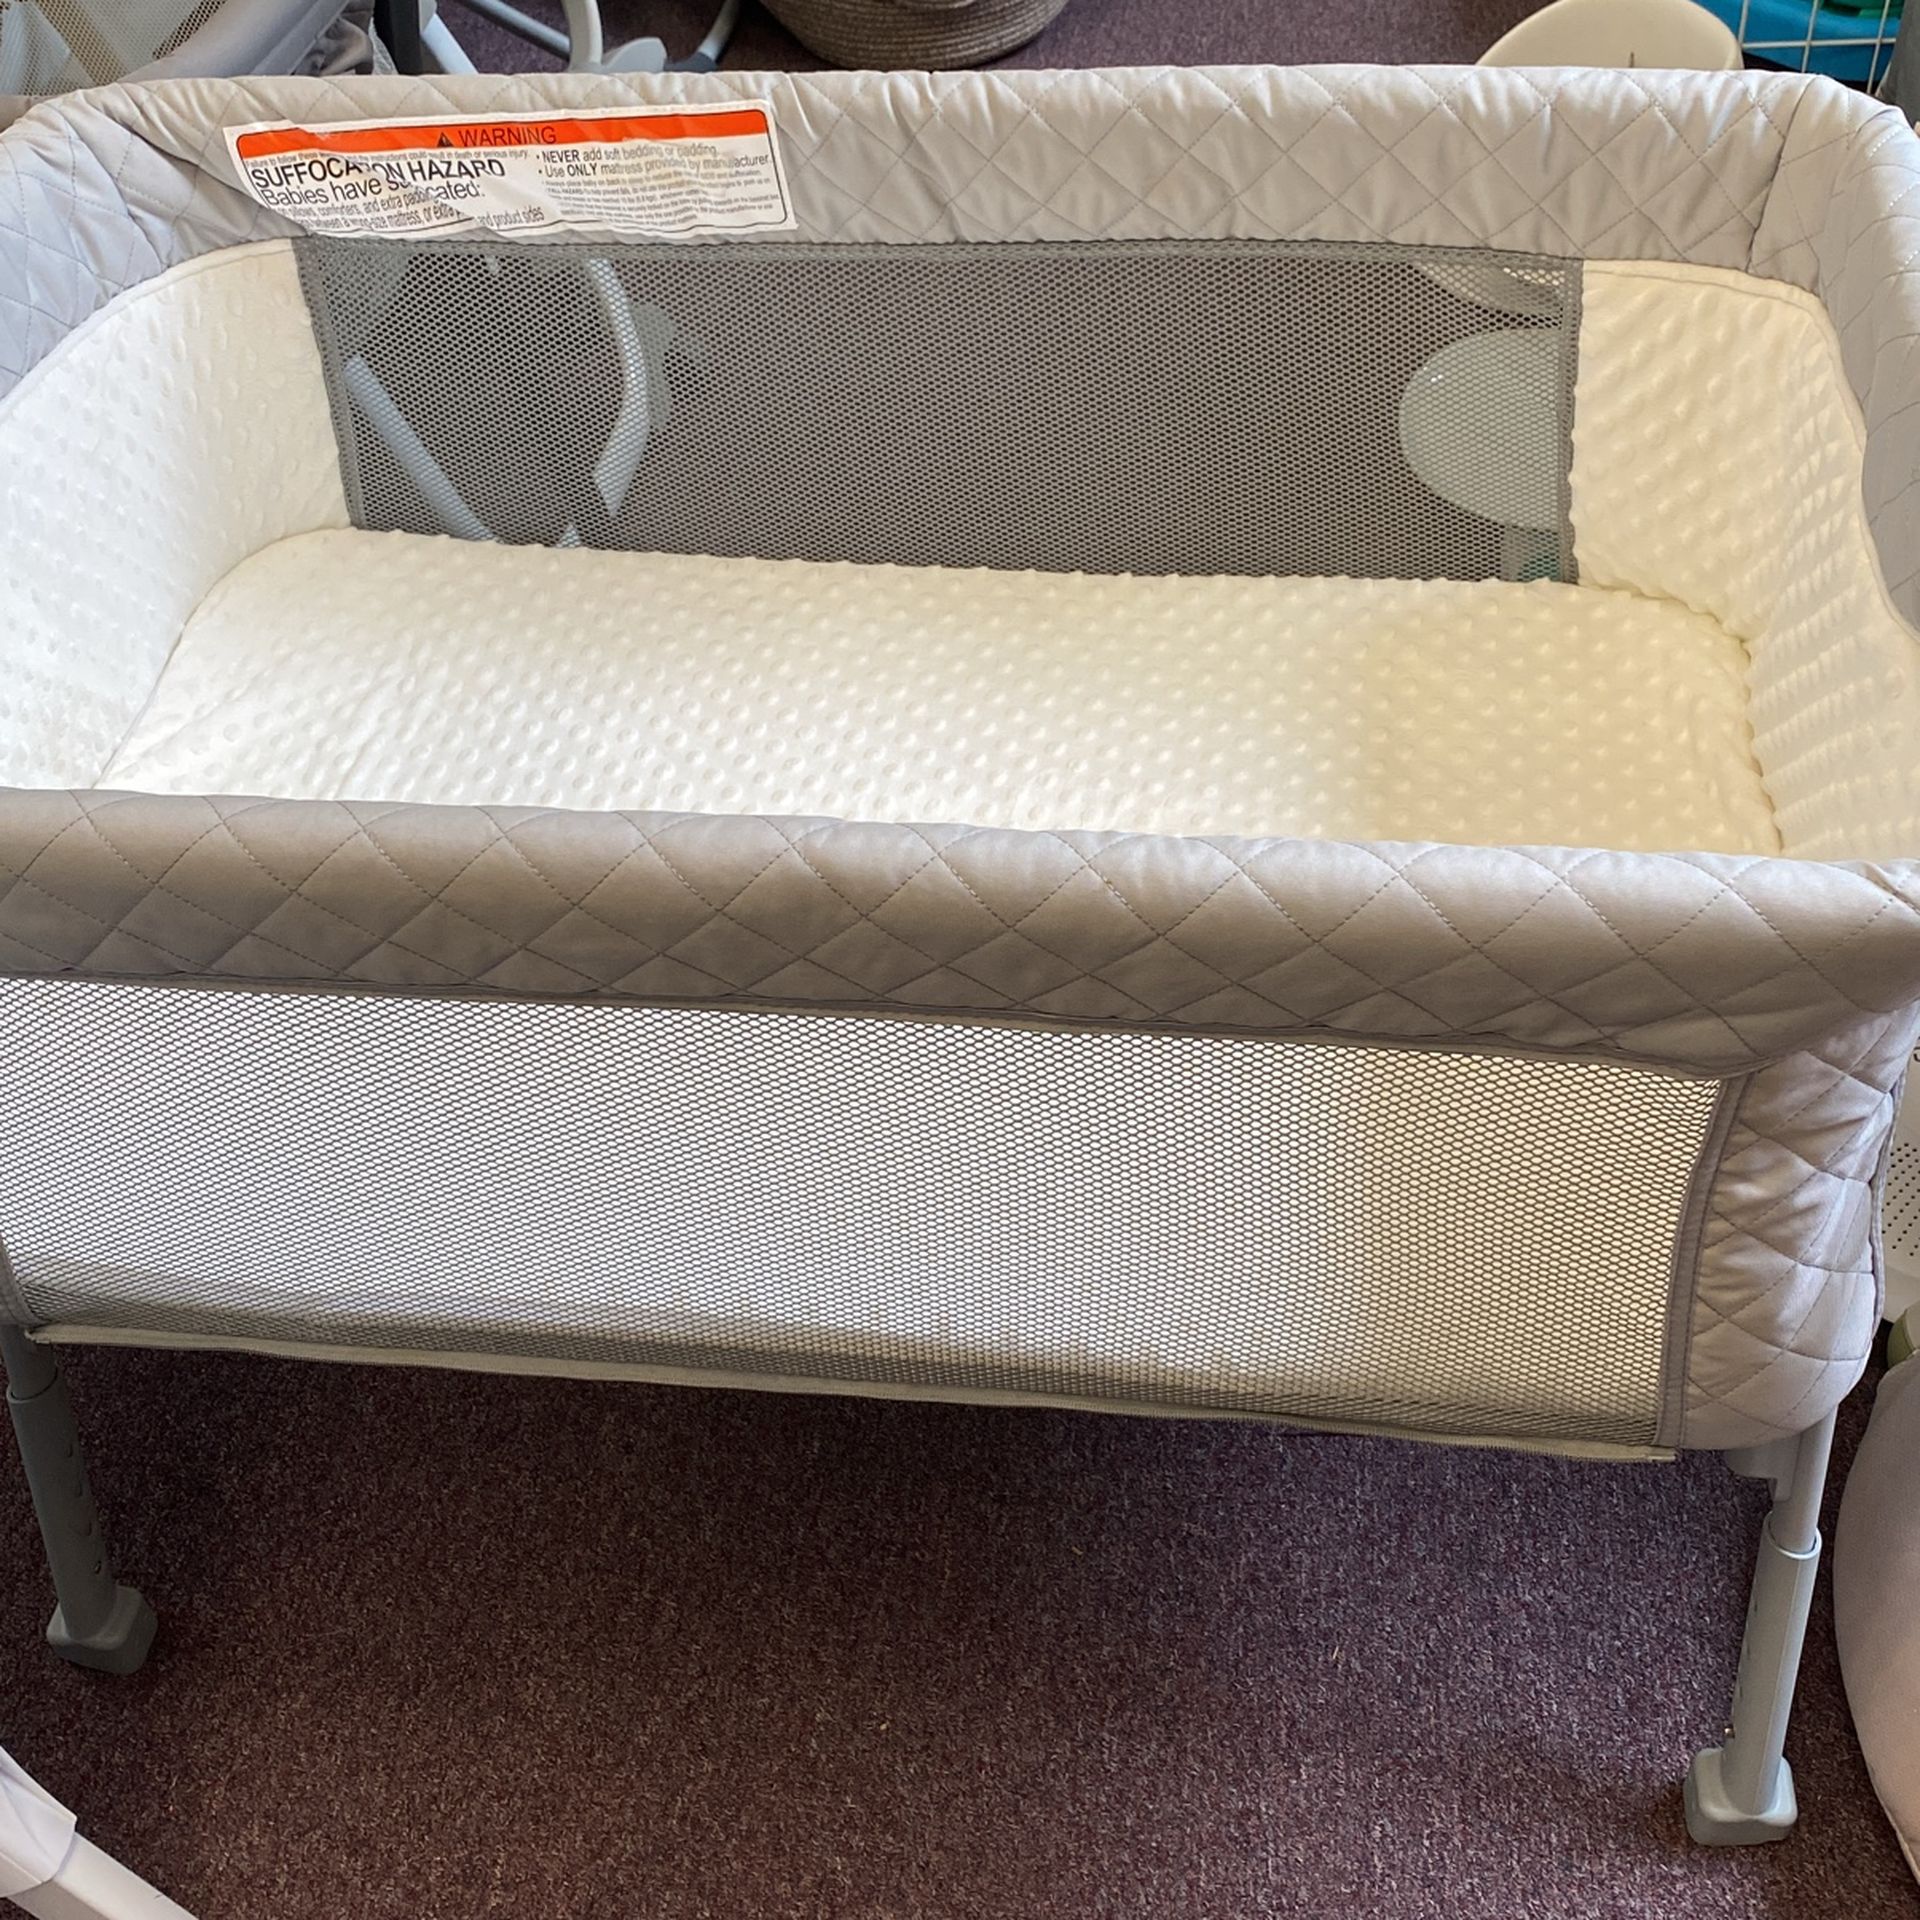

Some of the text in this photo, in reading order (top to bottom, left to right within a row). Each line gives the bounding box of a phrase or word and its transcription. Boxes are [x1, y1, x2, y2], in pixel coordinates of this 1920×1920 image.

[457, 126, 557, 148] WARNING
[542, 150, 580, 163] NEVER
[583, 148, 602, 161] add
[251, 157, 505, 189] SUFFOCAON HAZARD
[545, 164, 565, 177] Use
[567, 163, 597, 177] ONLY
[261, 186, 330, 206] Babies
[329, 177, 382, 201] have
